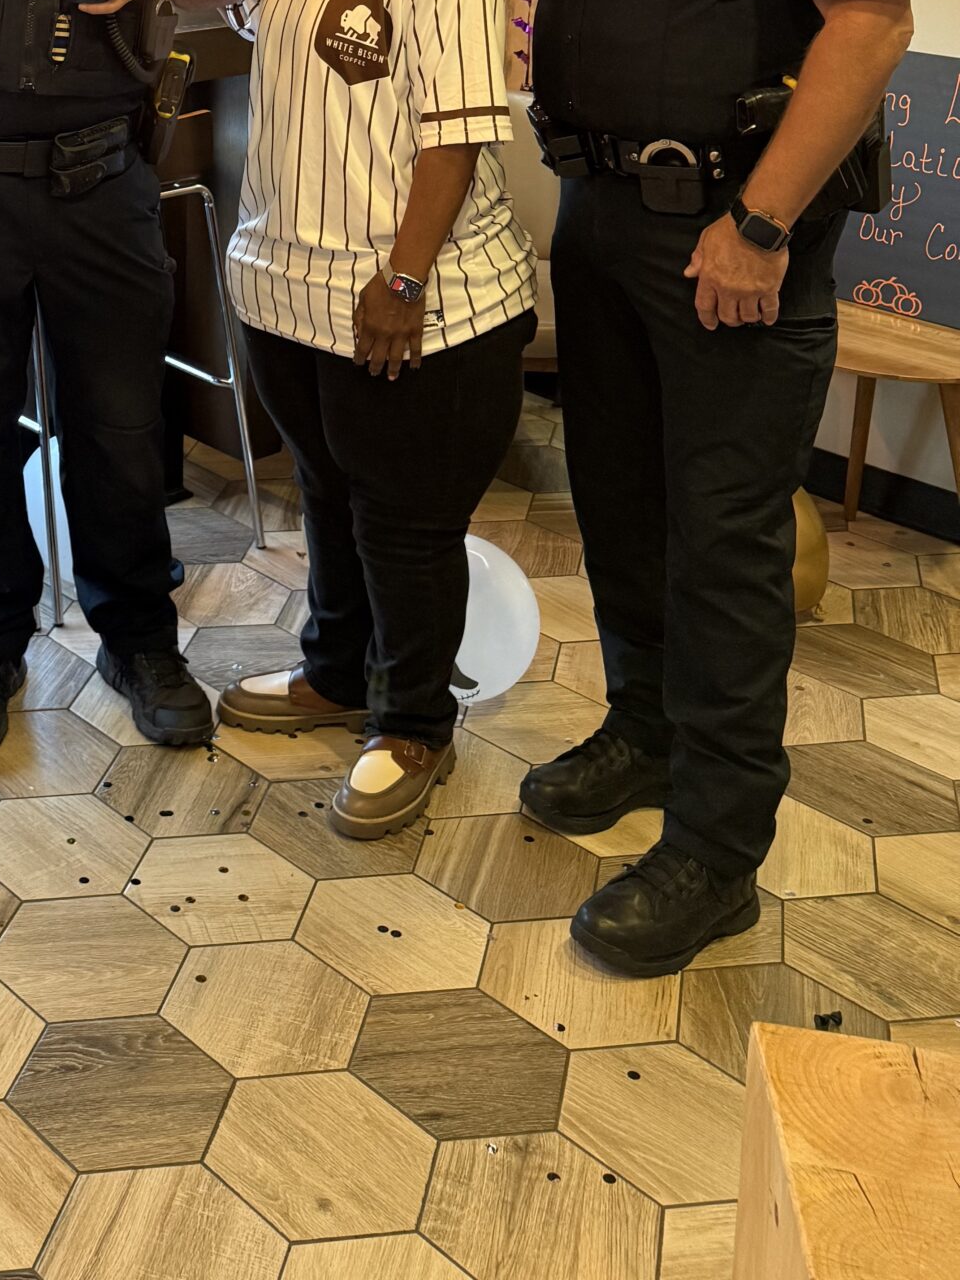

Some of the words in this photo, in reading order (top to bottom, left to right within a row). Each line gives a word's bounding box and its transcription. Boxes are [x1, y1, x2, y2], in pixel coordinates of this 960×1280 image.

[325, 37, 354, 54] WHITE
[357, 47, 385, 64] BISON
[339, 54, 366, 67] COFFEE
[885, 91, 911, 127] ng
[890, 182, 921, 221] y
[859, 213, 903, 246] Our
[925, 223, 960, 261] Co
